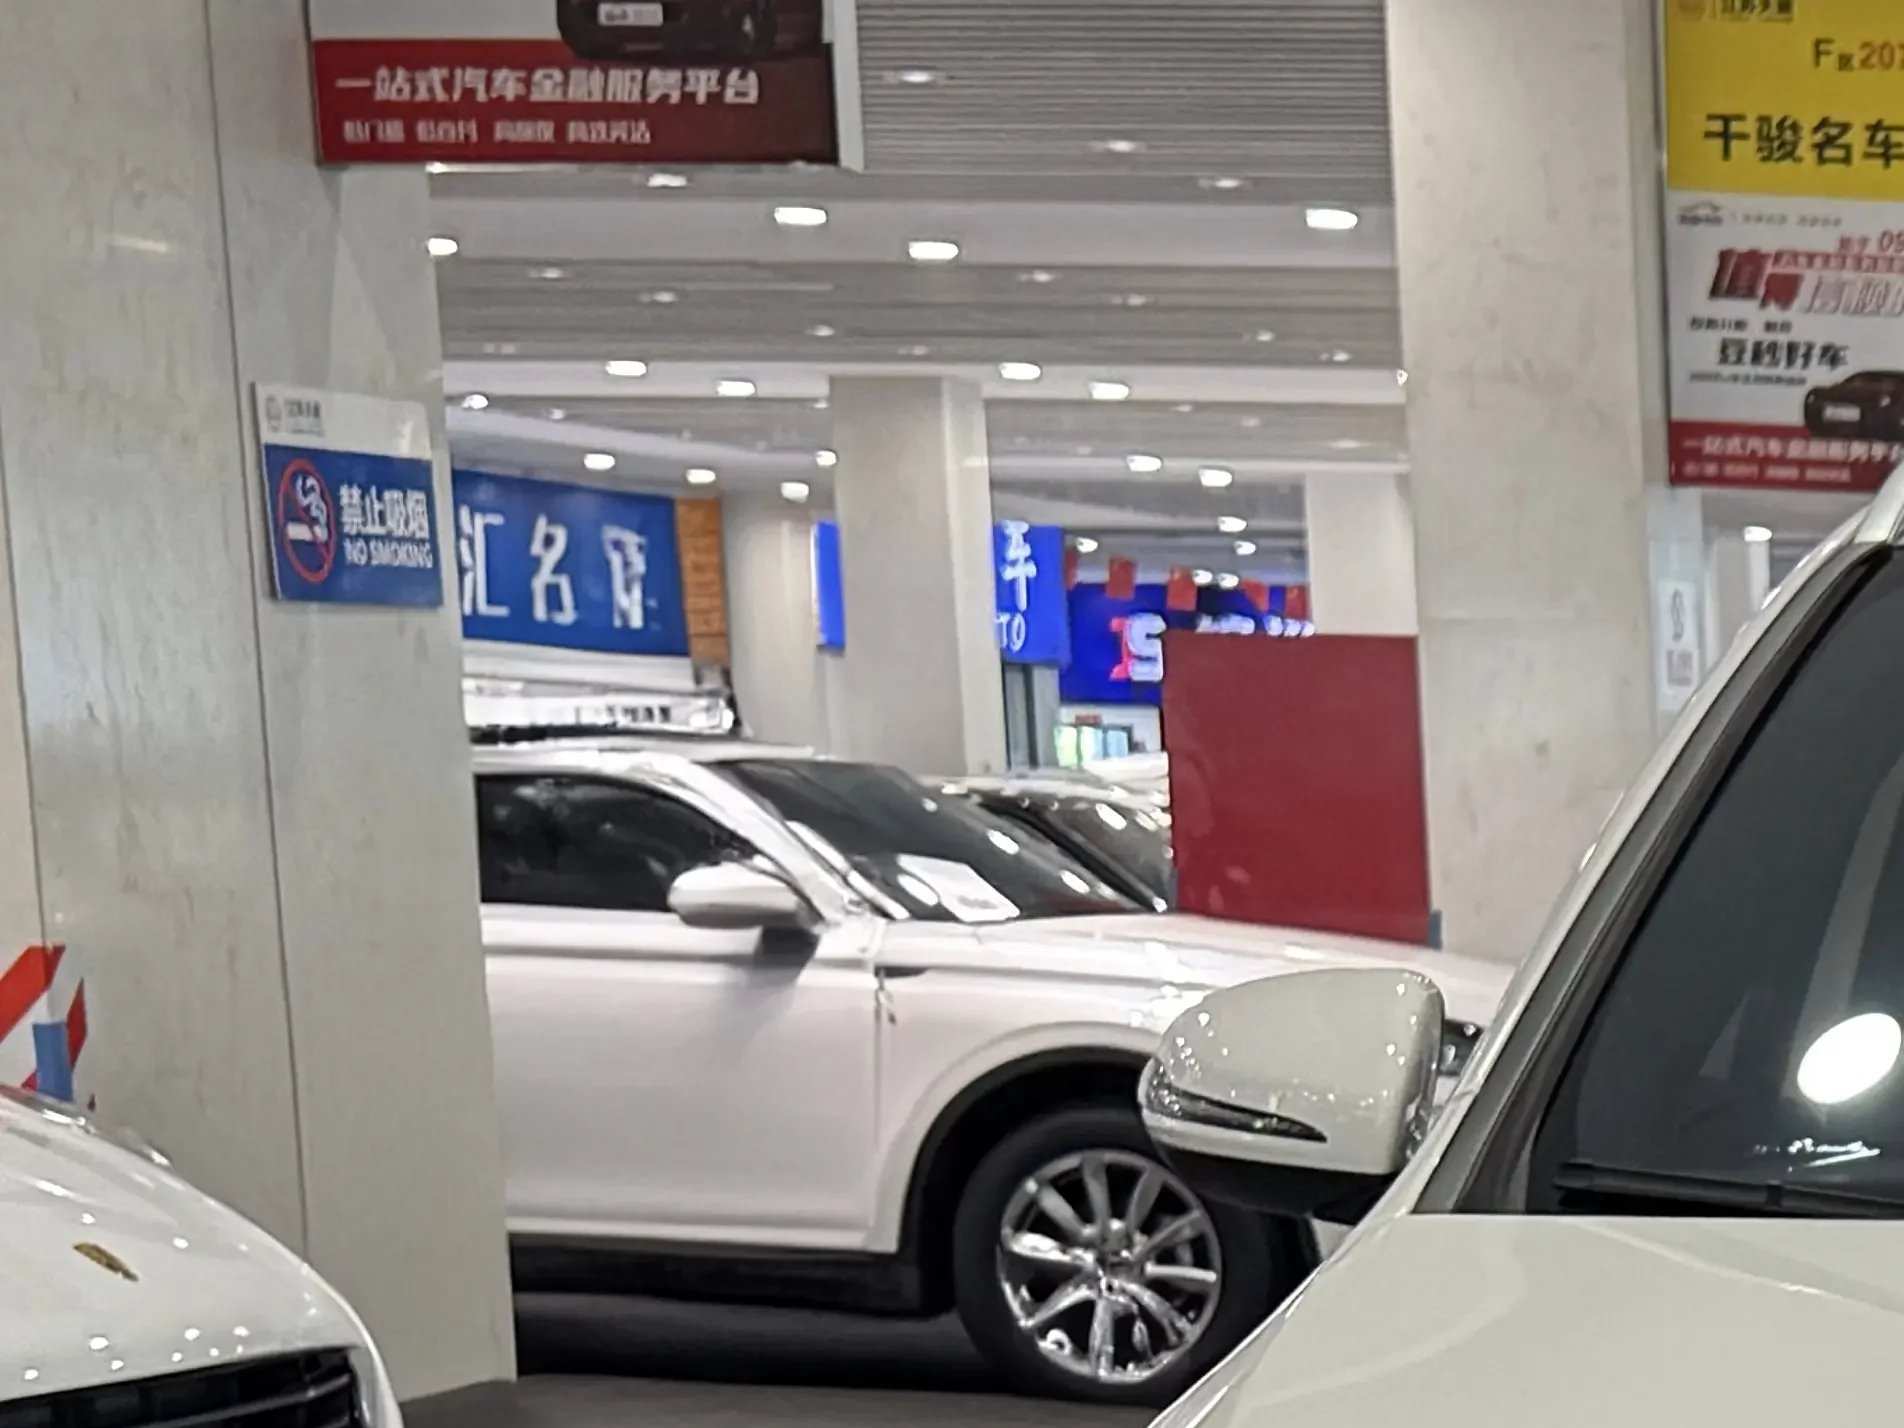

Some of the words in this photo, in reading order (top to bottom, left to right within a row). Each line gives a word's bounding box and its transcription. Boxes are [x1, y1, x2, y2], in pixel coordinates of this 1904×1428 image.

[335, 66, 759, 104] 一站式汽车金融服务平台
[338, 482, 430, 540] 禁止吸烟
[343, 537, 367, 566] NO
[369, 538, 433, 568] SMOKING
[457, 504, 647, 630] 汇名
